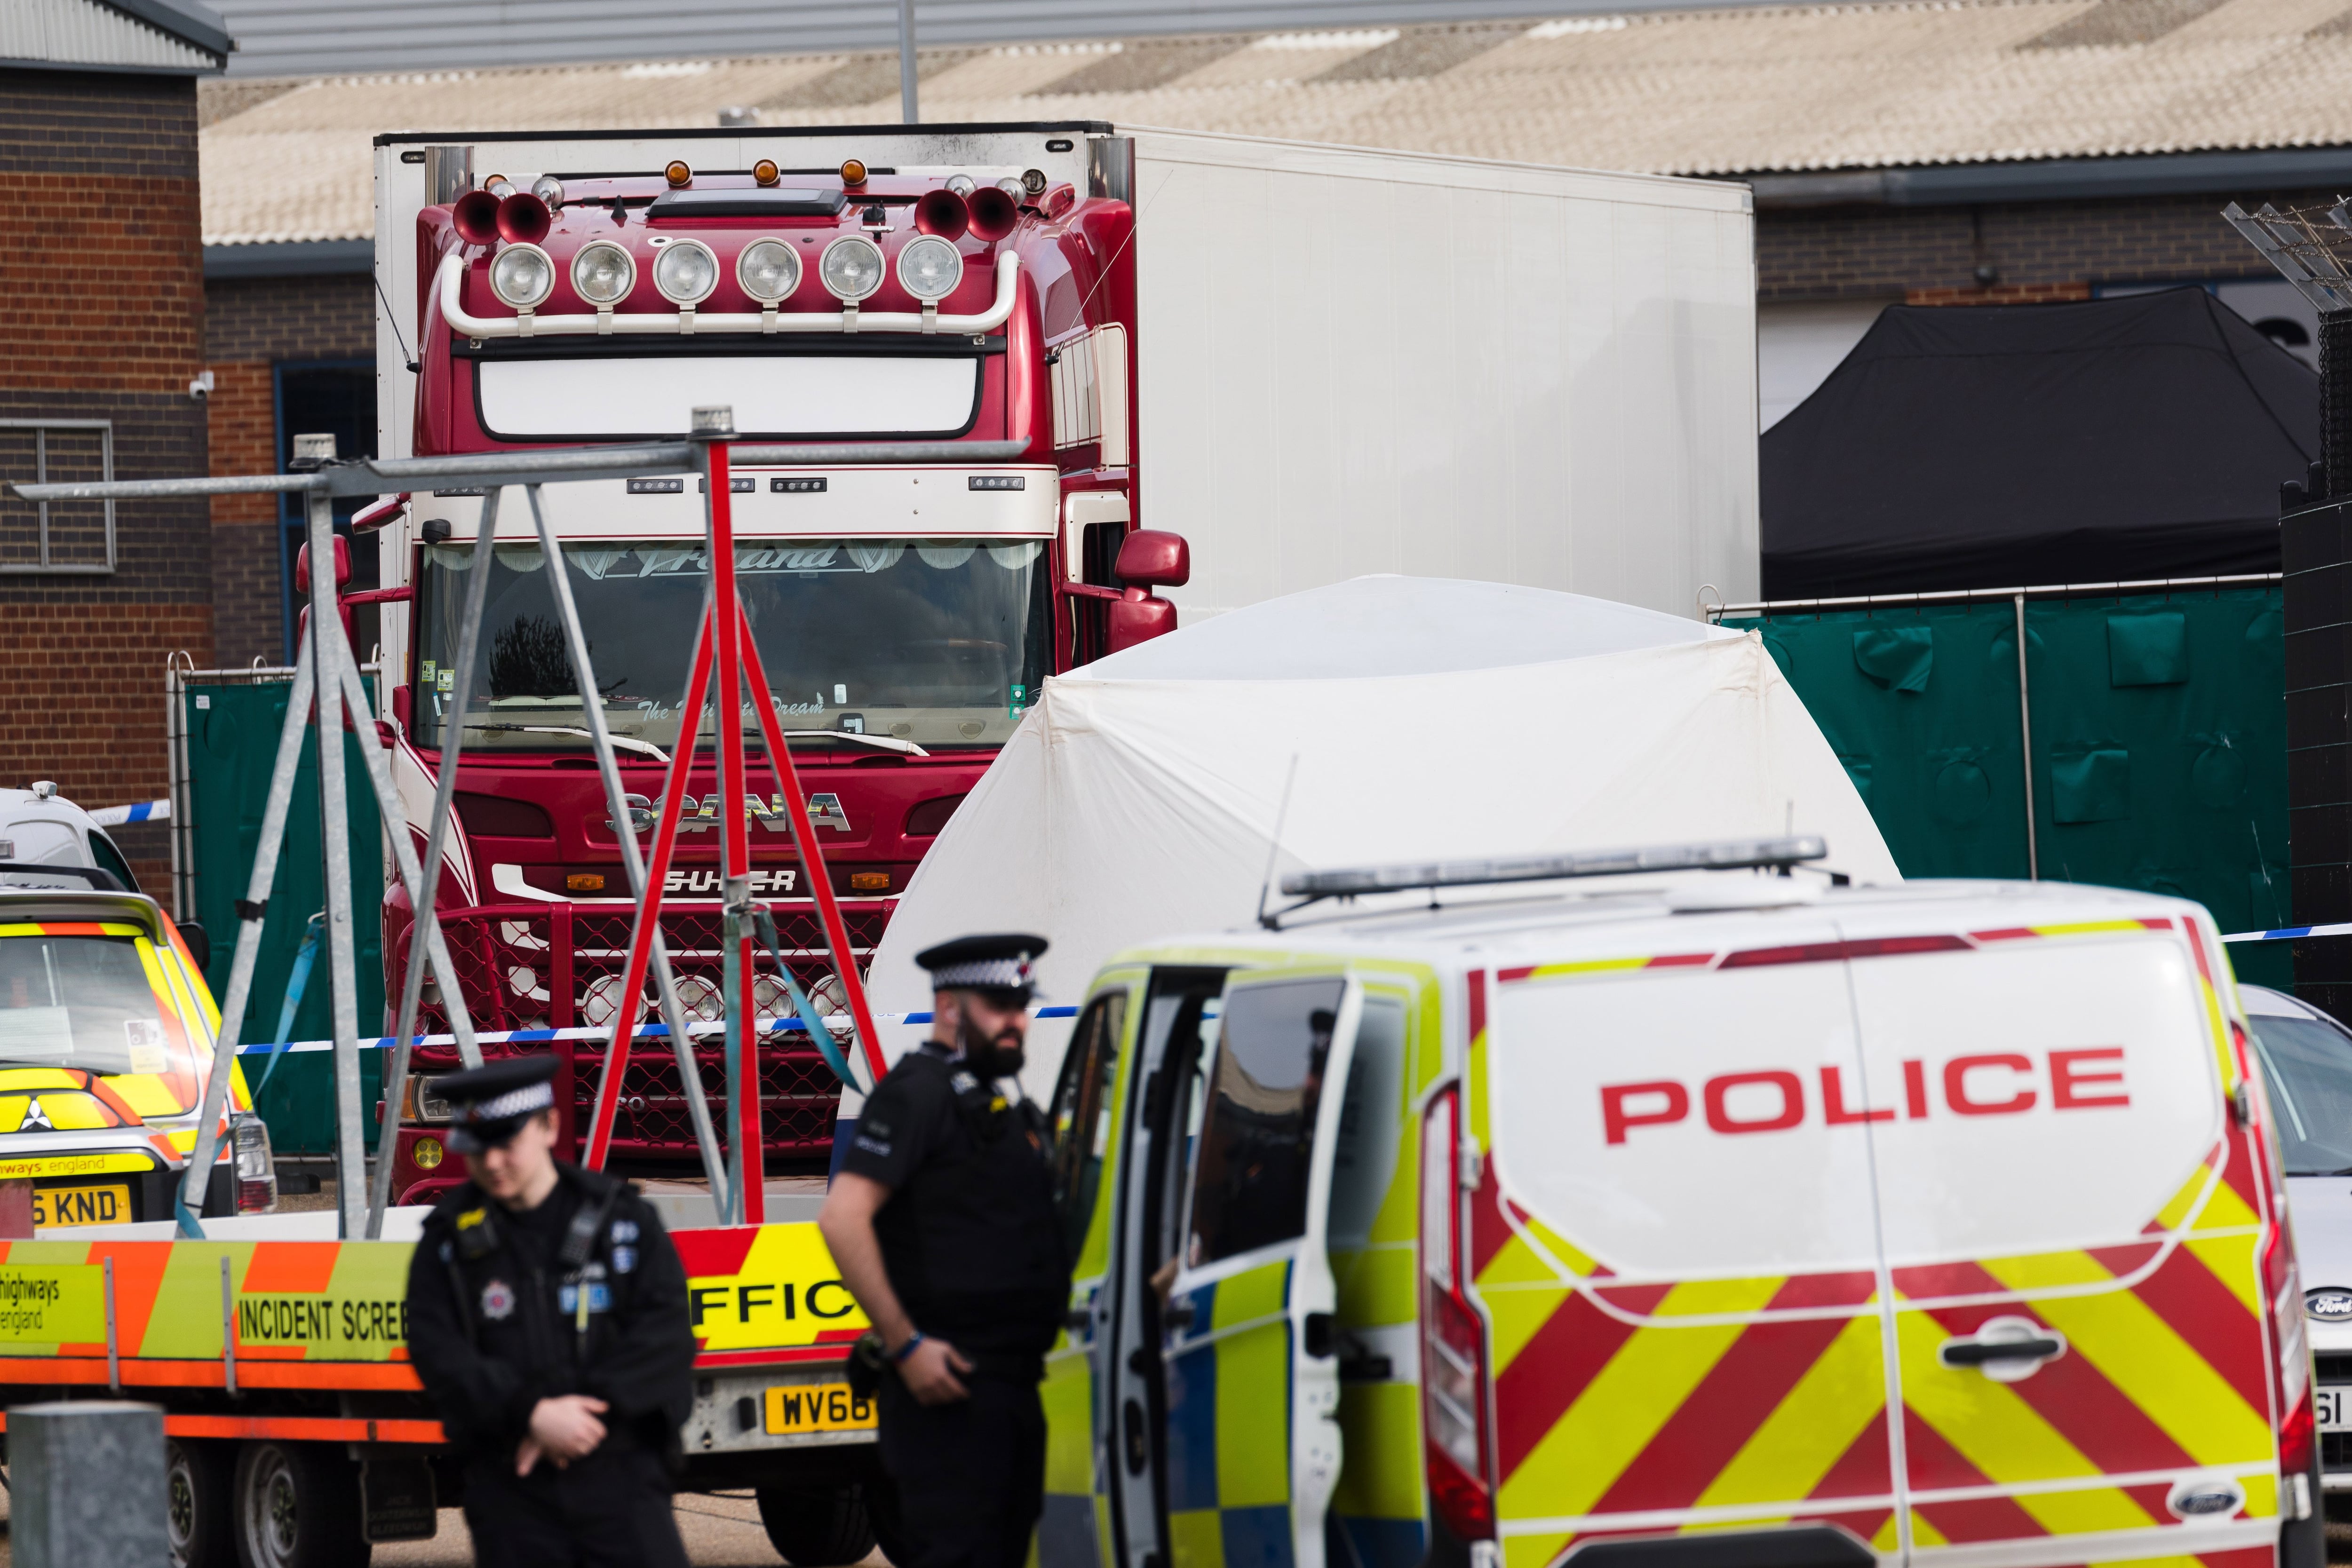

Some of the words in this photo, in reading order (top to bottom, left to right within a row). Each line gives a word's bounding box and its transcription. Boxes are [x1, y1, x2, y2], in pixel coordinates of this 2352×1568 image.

[637, 701, 668, 721] The
[663, 871, 795, 891] SUER
[1599, 1047, 2130, 1145] POLICE
[49, 1157, 105, 1173] england
[55, 1191, 116, 1223] KND
[2315, 1296, 2352, 1313] Ford
[239, 1299, 333, 1339] INCIDENT
[783, 1391, 870, 1425] WV66
